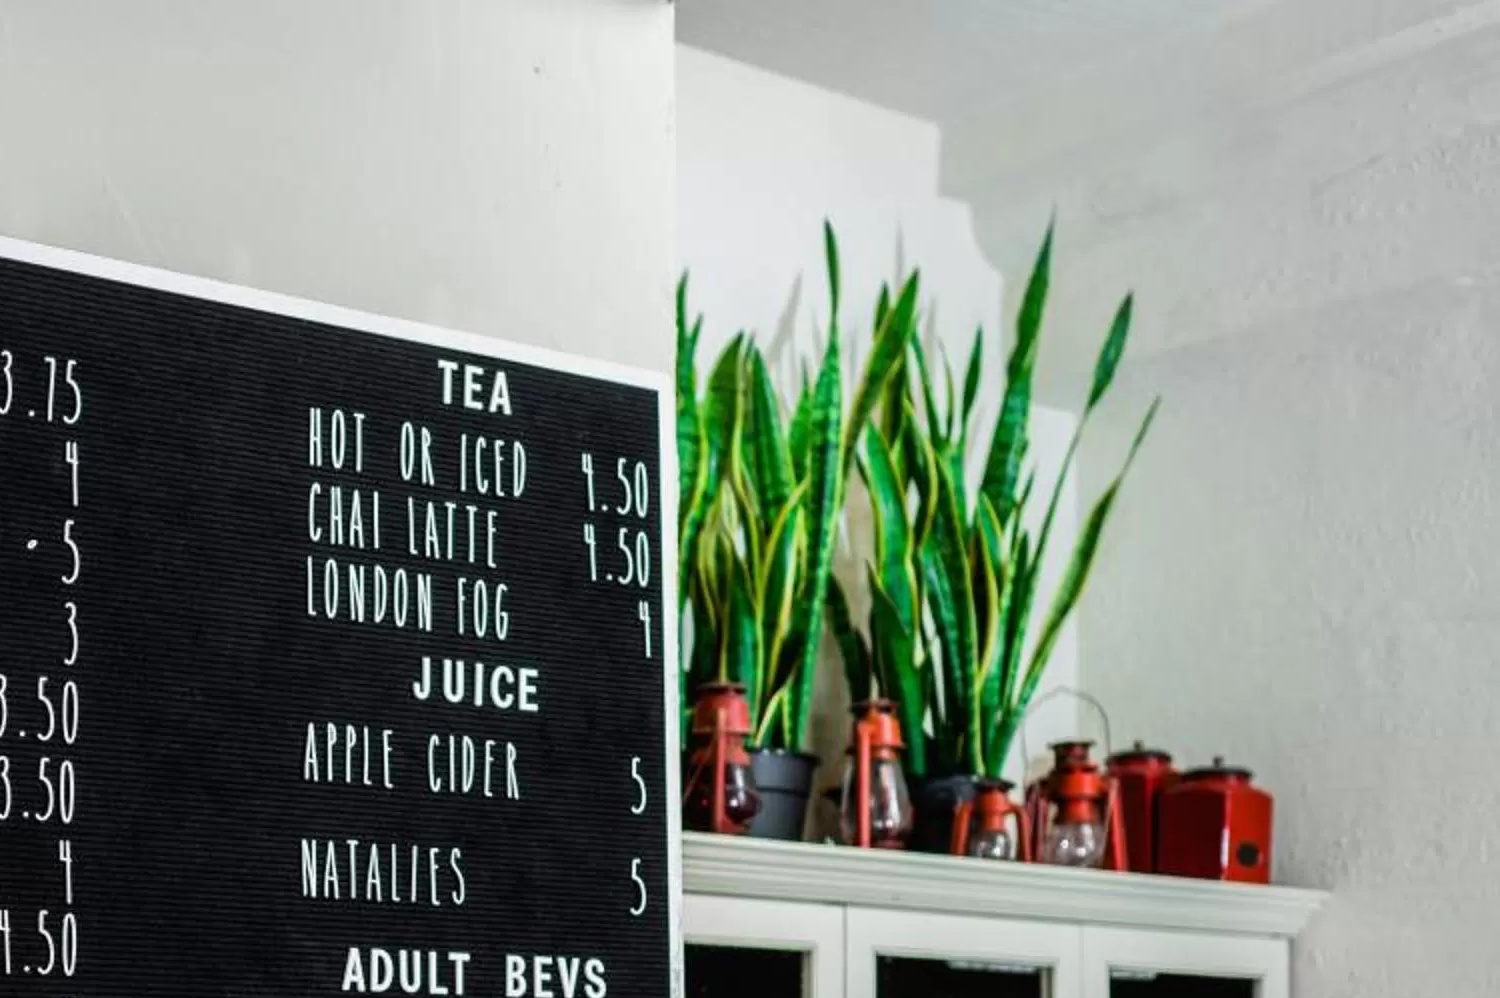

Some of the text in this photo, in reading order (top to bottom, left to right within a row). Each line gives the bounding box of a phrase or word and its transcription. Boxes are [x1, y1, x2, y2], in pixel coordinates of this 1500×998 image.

[437, 359, 513, 416] TEA
[65, 440, 79, 507] 4
[309, 407, 649, 519] HOT OR ICED 4.50
[61, 519, 81, 585] 5
[308, 481, 650, 588] CHAI LATTE 4.50
[63, 601, 79, 666] 3
[307, 555, 652, 659] LONDON FOG 4
[412, 656, 539, 712] JUICE
[304, 721, 647, 815] APPLE CIDER 5
[59, 839, 73, 905] 4
[301, 838, 647, 916] NATALIES 5
[341, 947, 471, 996] ADULT
